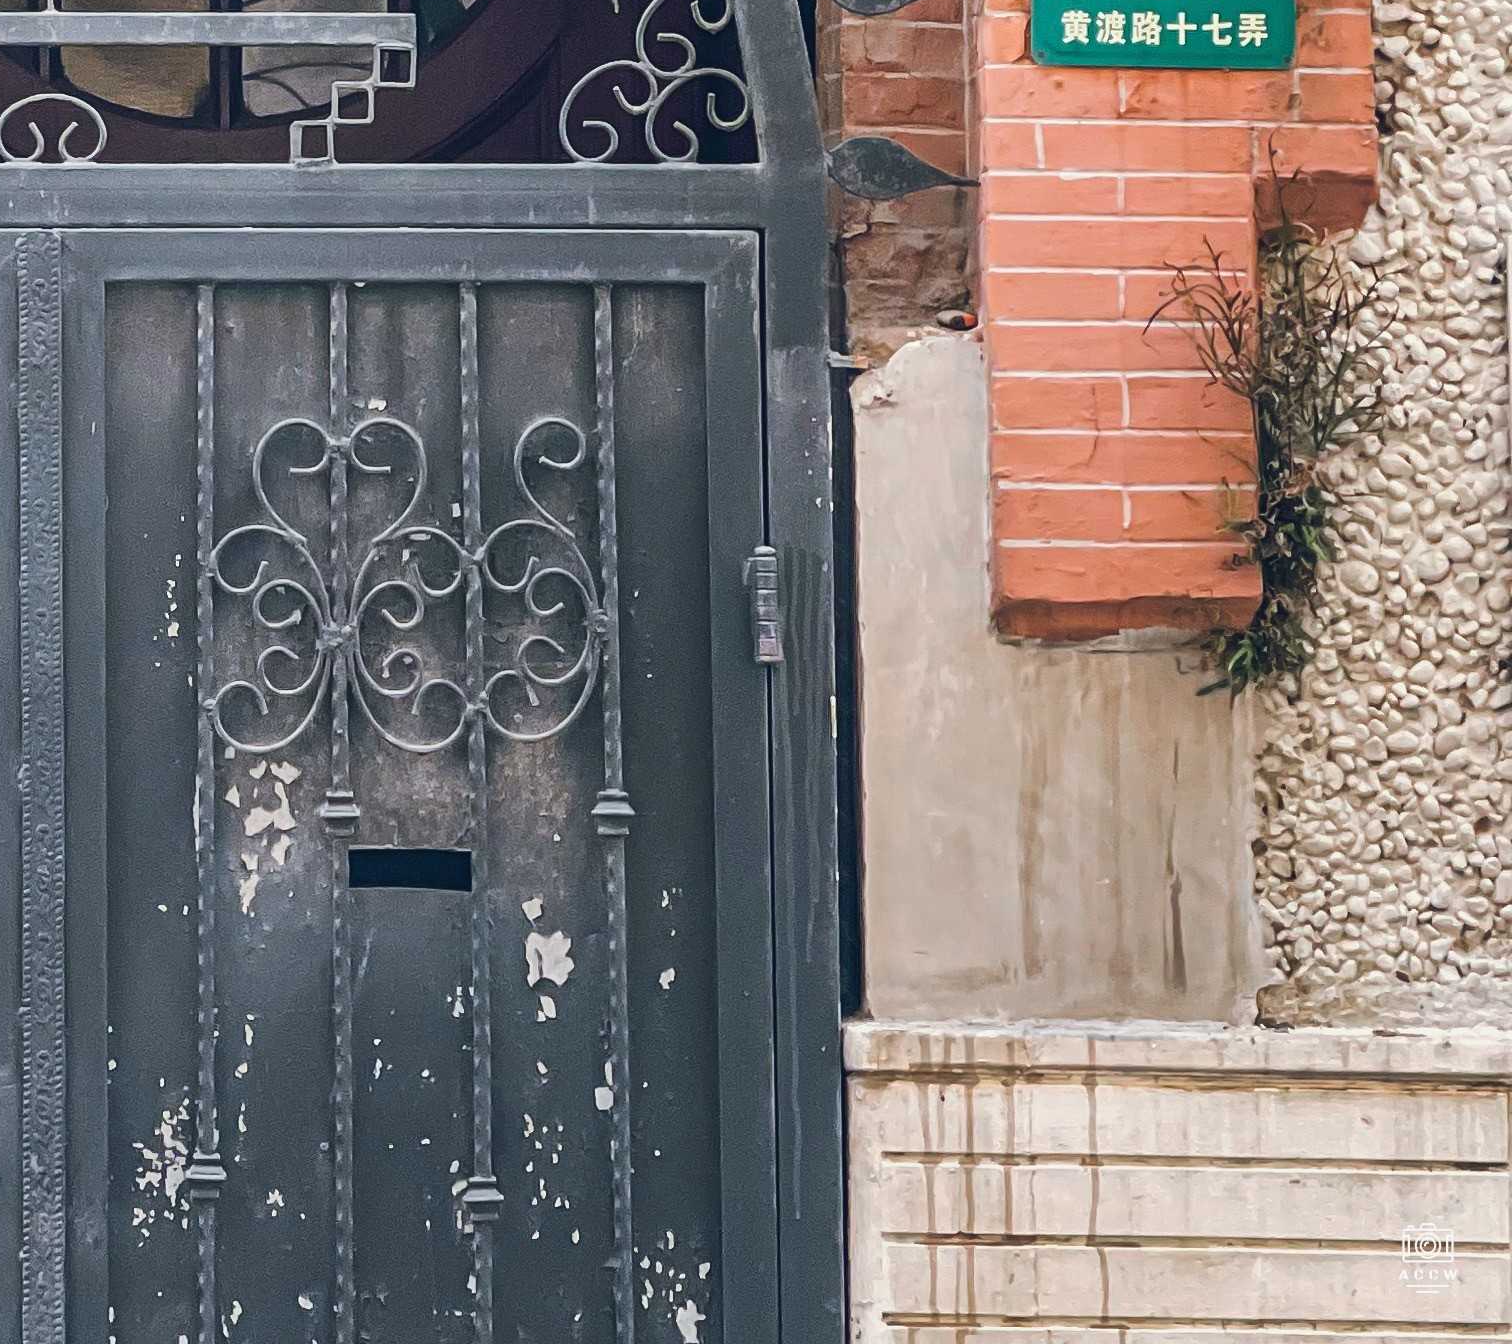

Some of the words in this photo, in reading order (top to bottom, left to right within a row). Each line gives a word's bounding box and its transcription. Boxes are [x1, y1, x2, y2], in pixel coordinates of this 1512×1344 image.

[1060, 9, 1269, 47] 黄渡路十七弄
